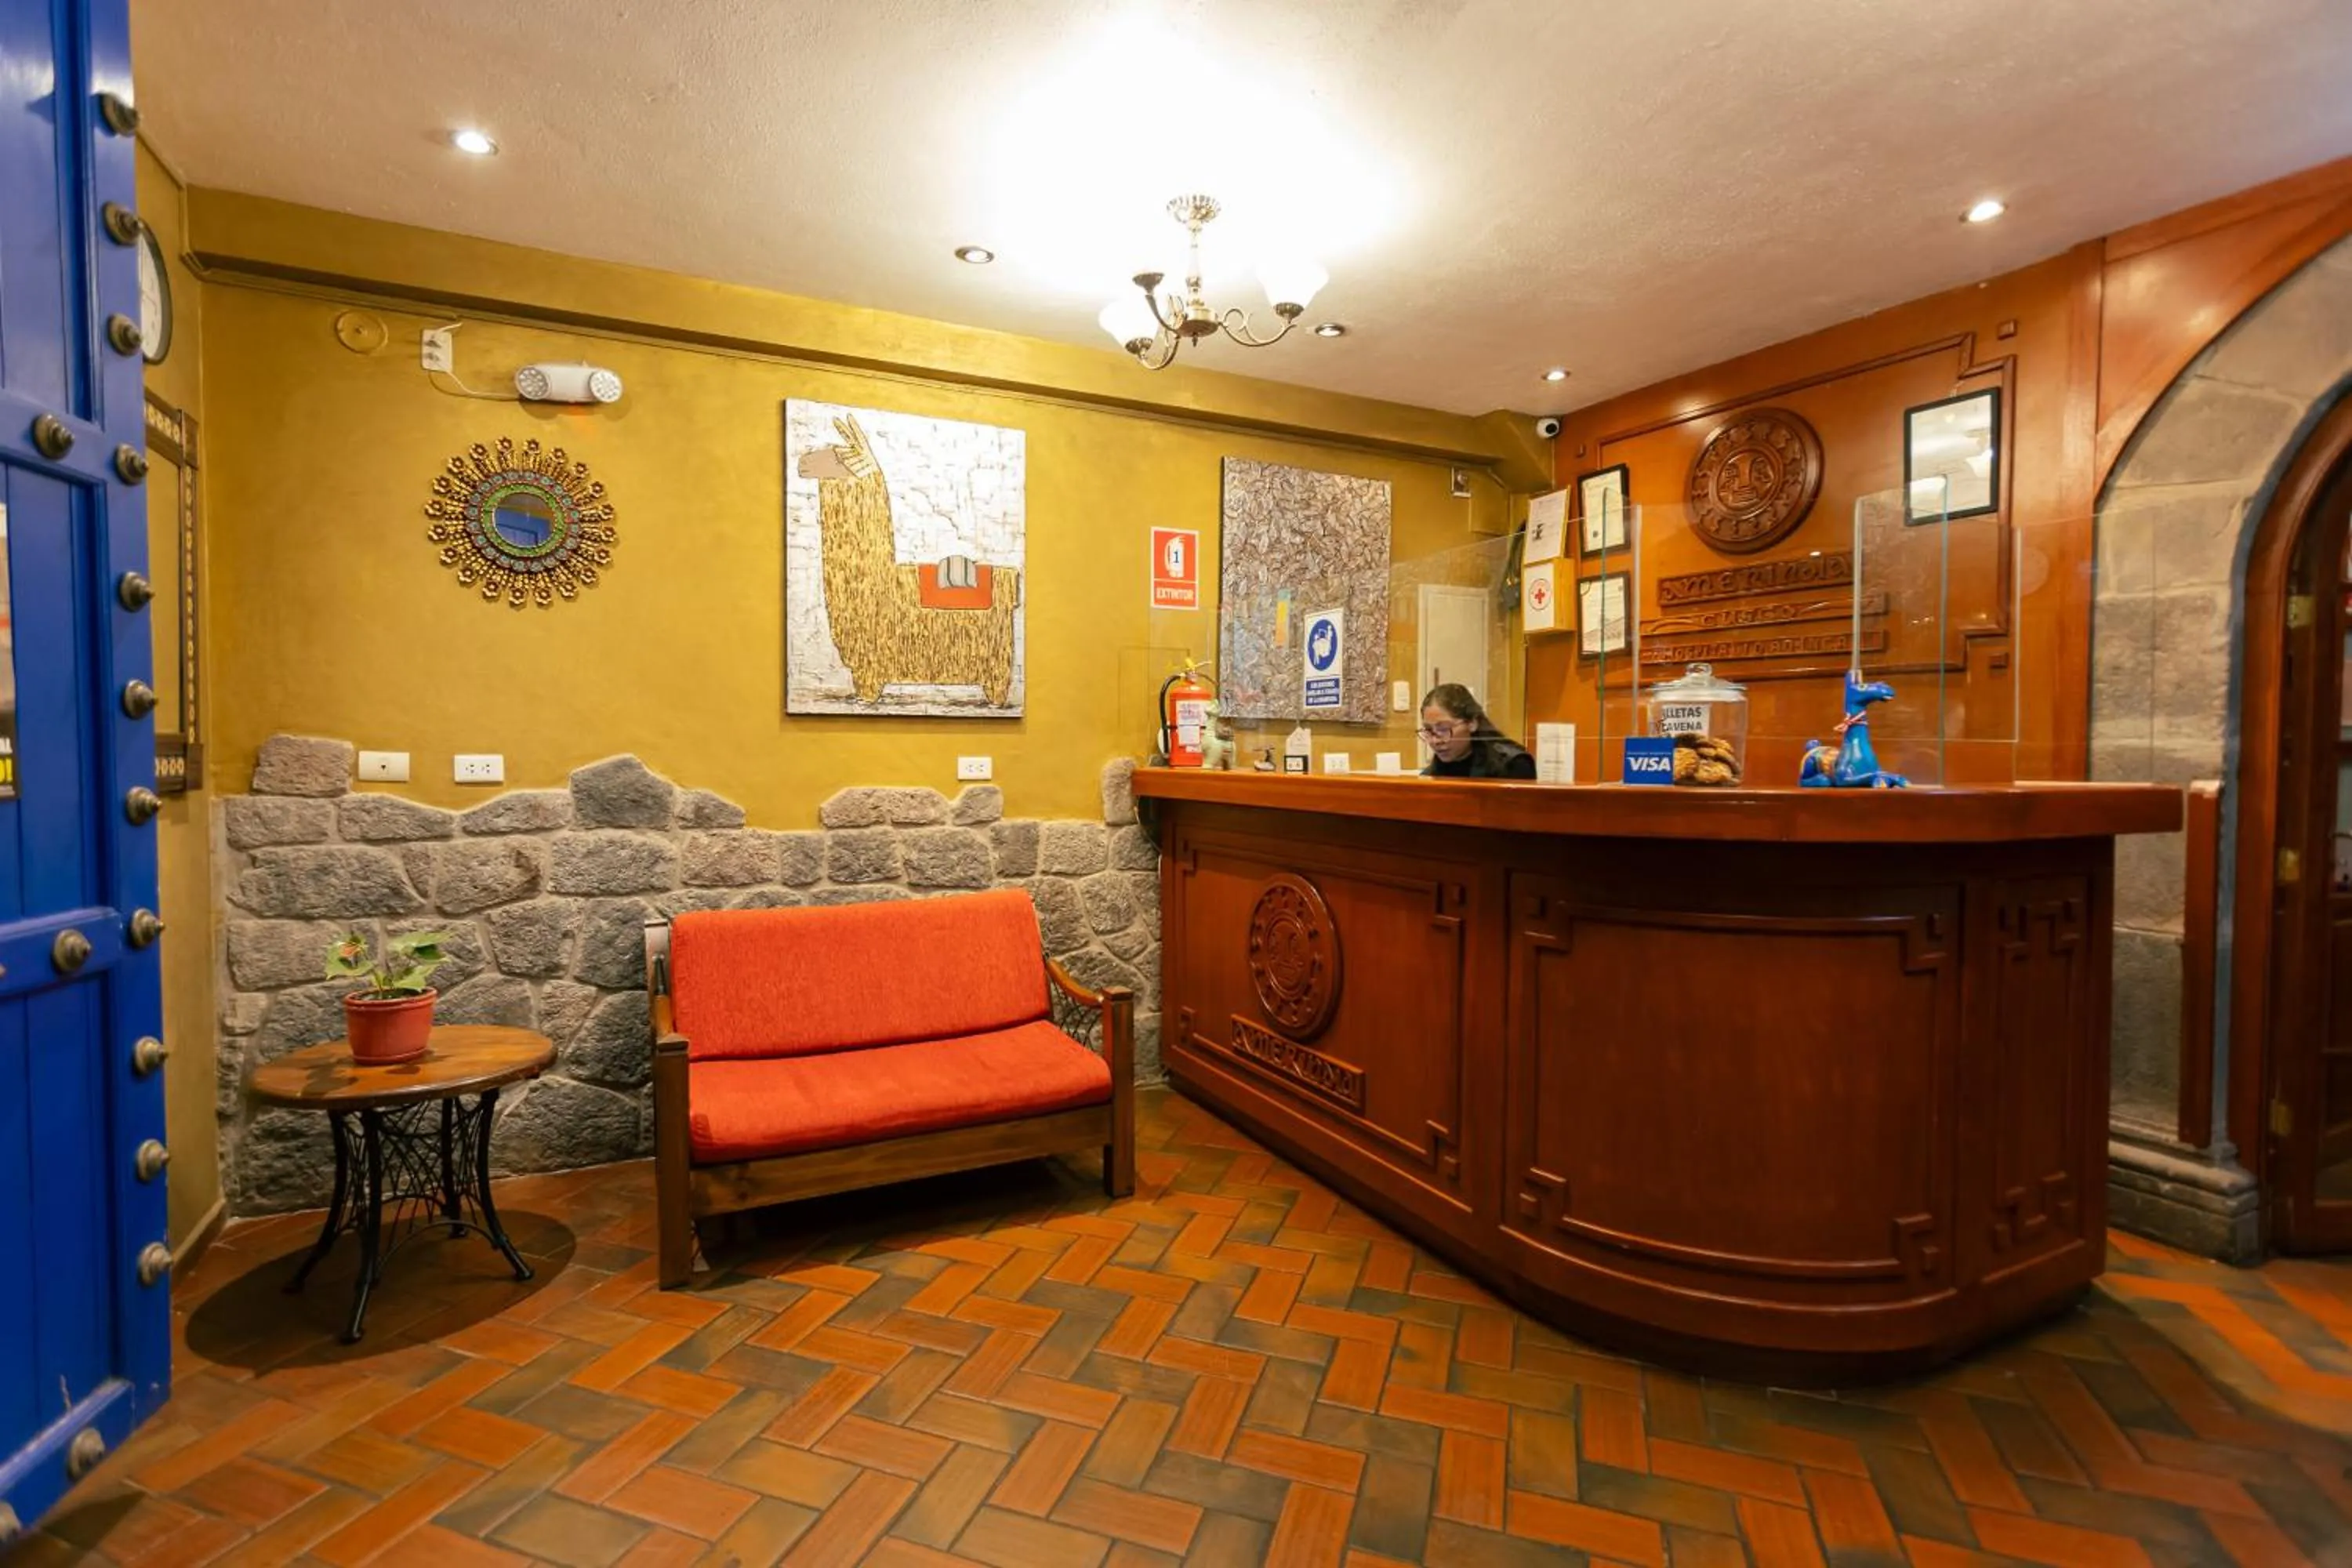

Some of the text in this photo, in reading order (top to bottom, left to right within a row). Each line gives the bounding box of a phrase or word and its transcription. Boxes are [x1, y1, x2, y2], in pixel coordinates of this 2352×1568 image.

[1156, 587, 1194, 601] EXTINTOR
[1701, 606, 1797, 626] CUSCO
[1627, 757, 1671, 771] VISA
